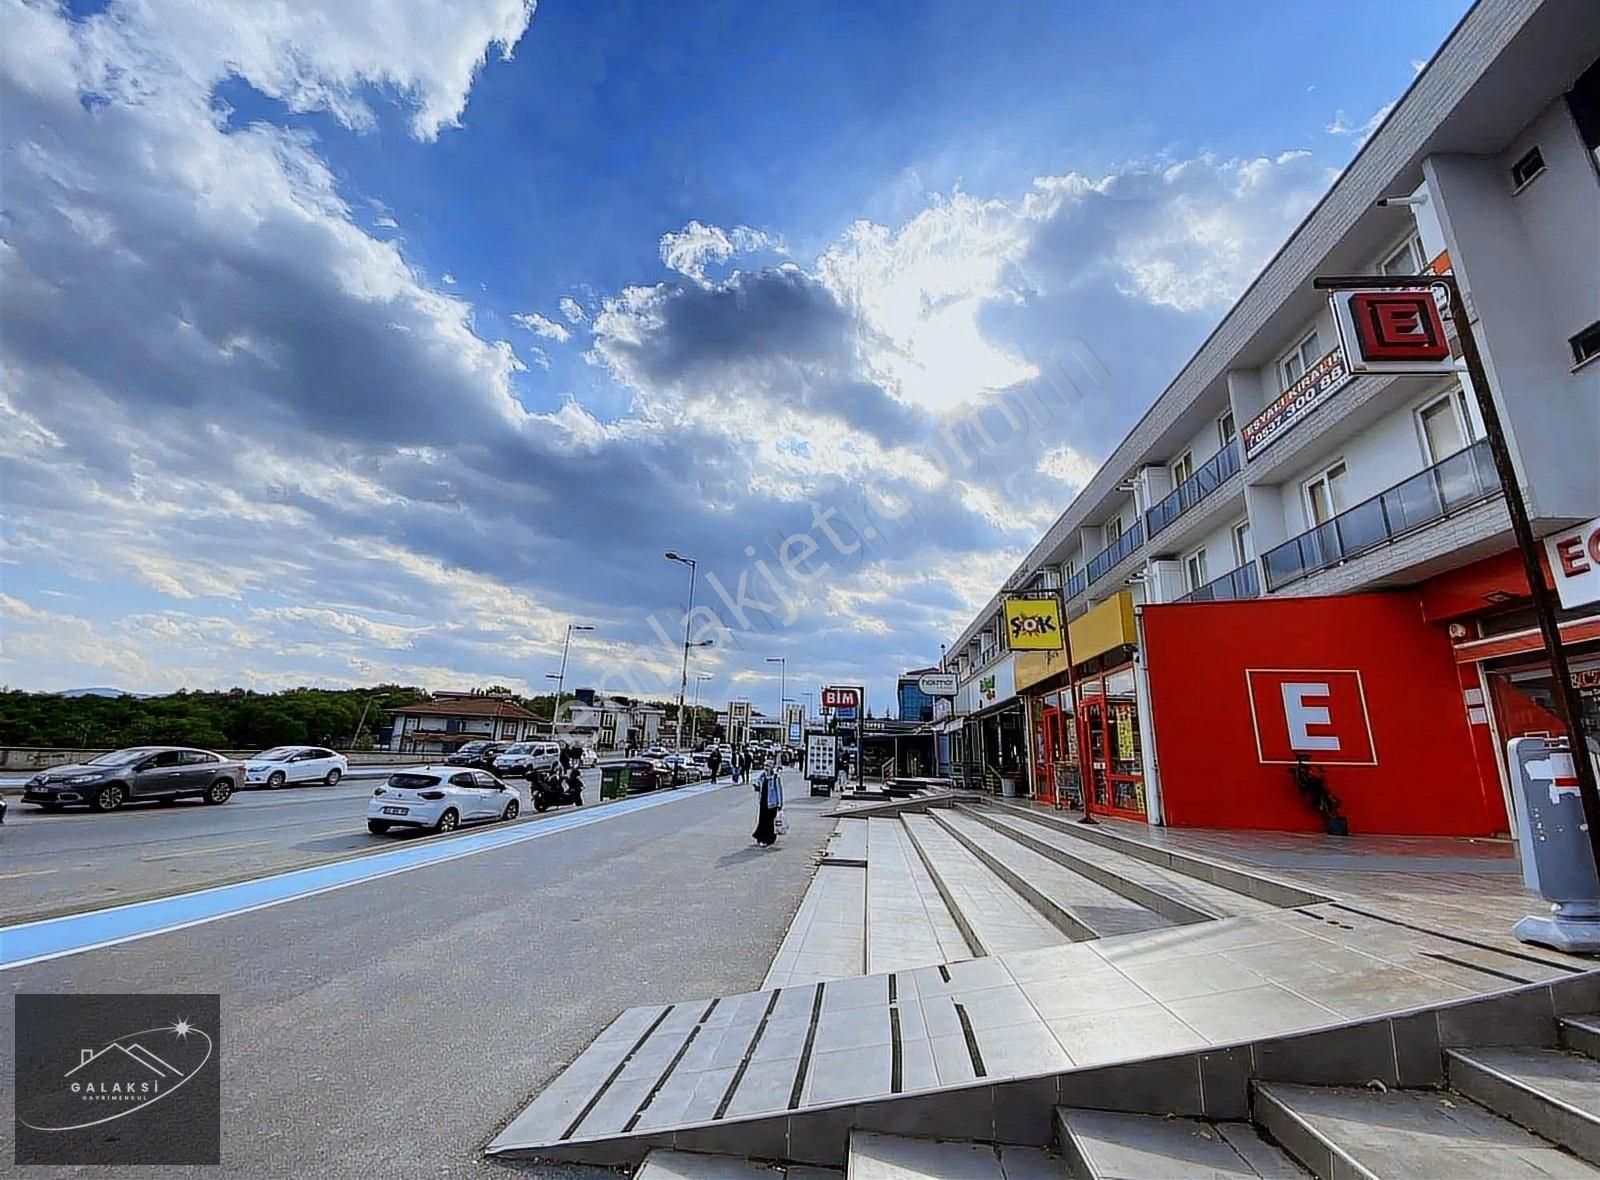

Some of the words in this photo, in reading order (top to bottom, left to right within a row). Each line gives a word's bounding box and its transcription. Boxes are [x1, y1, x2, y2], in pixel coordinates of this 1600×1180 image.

[1375, 303, 1428, 343] E
[1255, 415, 1282, 443] 0537
[1286, 387, 1315, 417] 300
[1010, 615, 1056, 638] ŞOK
[1280, 682, 1341, 751] E
